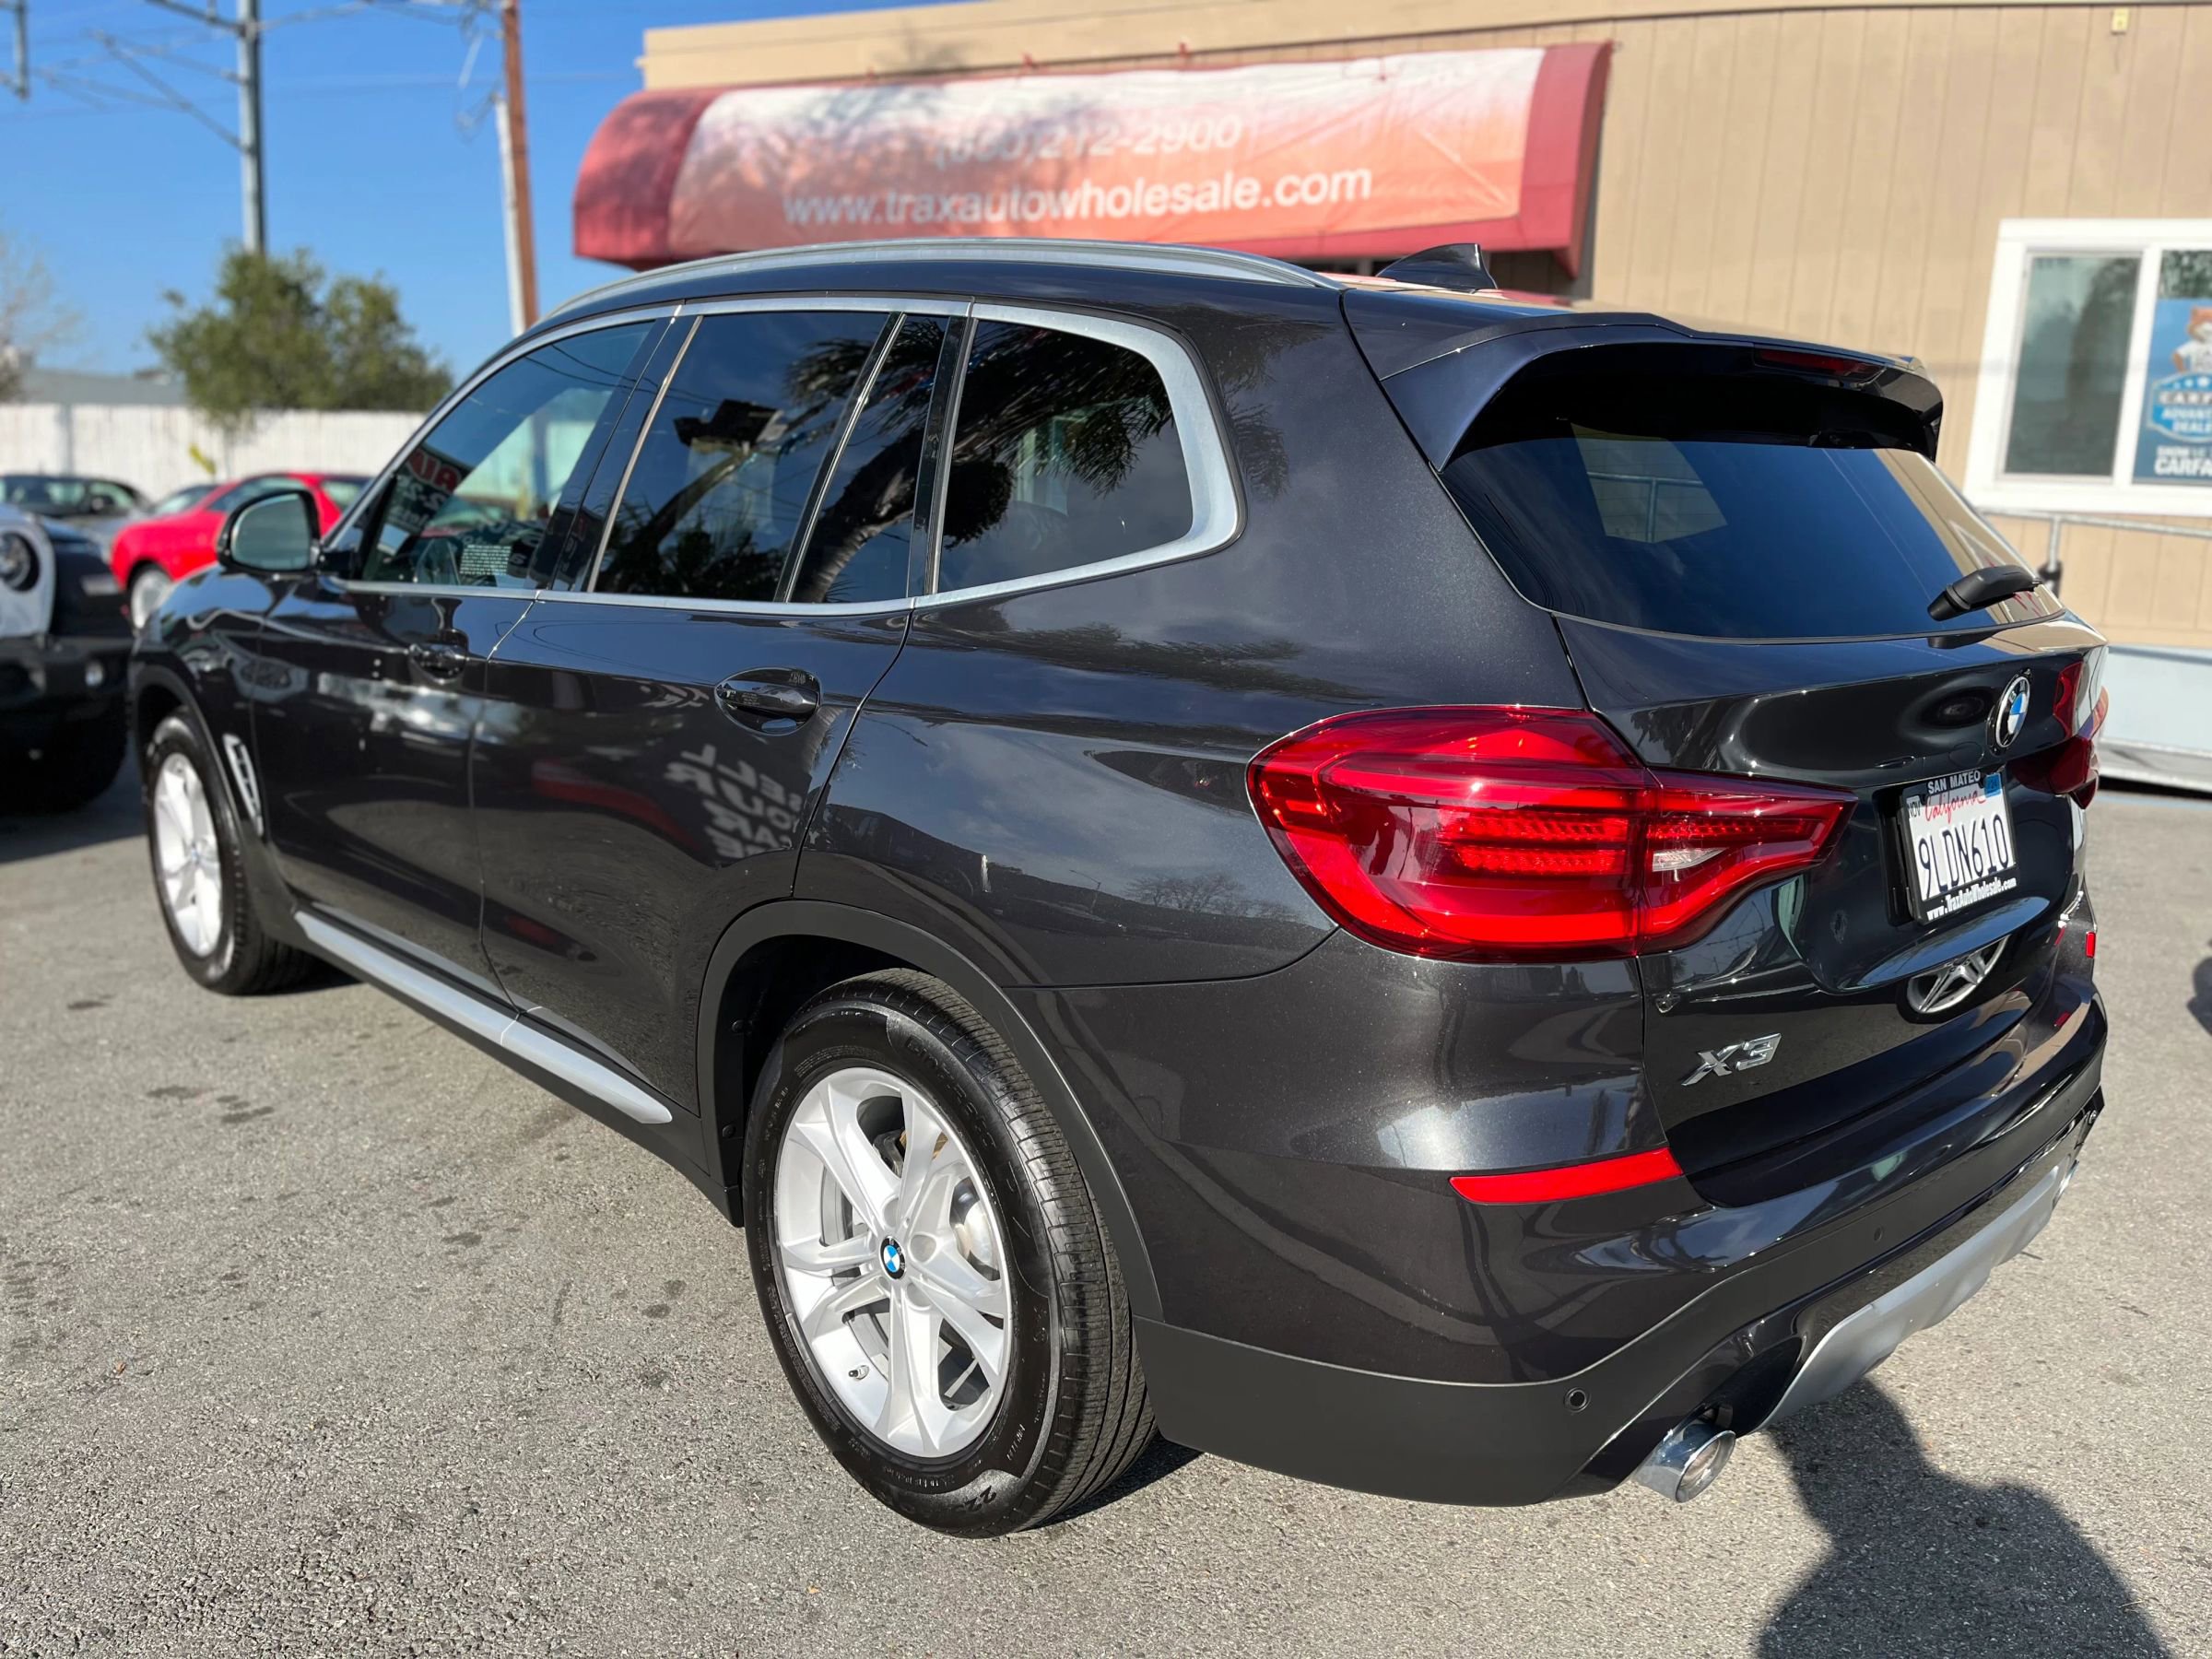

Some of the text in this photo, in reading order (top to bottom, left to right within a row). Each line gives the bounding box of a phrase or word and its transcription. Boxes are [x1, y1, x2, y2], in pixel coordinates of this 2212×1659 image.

[781, 166, 1372, 226] www.traxautowholesale.com
[1924, 788, 1986, 824] California
[1927, 777, 1947, 794] SAN
[1949, 771, 1981, 789] MATEO
[1917, 813, 2009, 900] 9LDN610
[1681, 1032, 1783, 1087] X3
